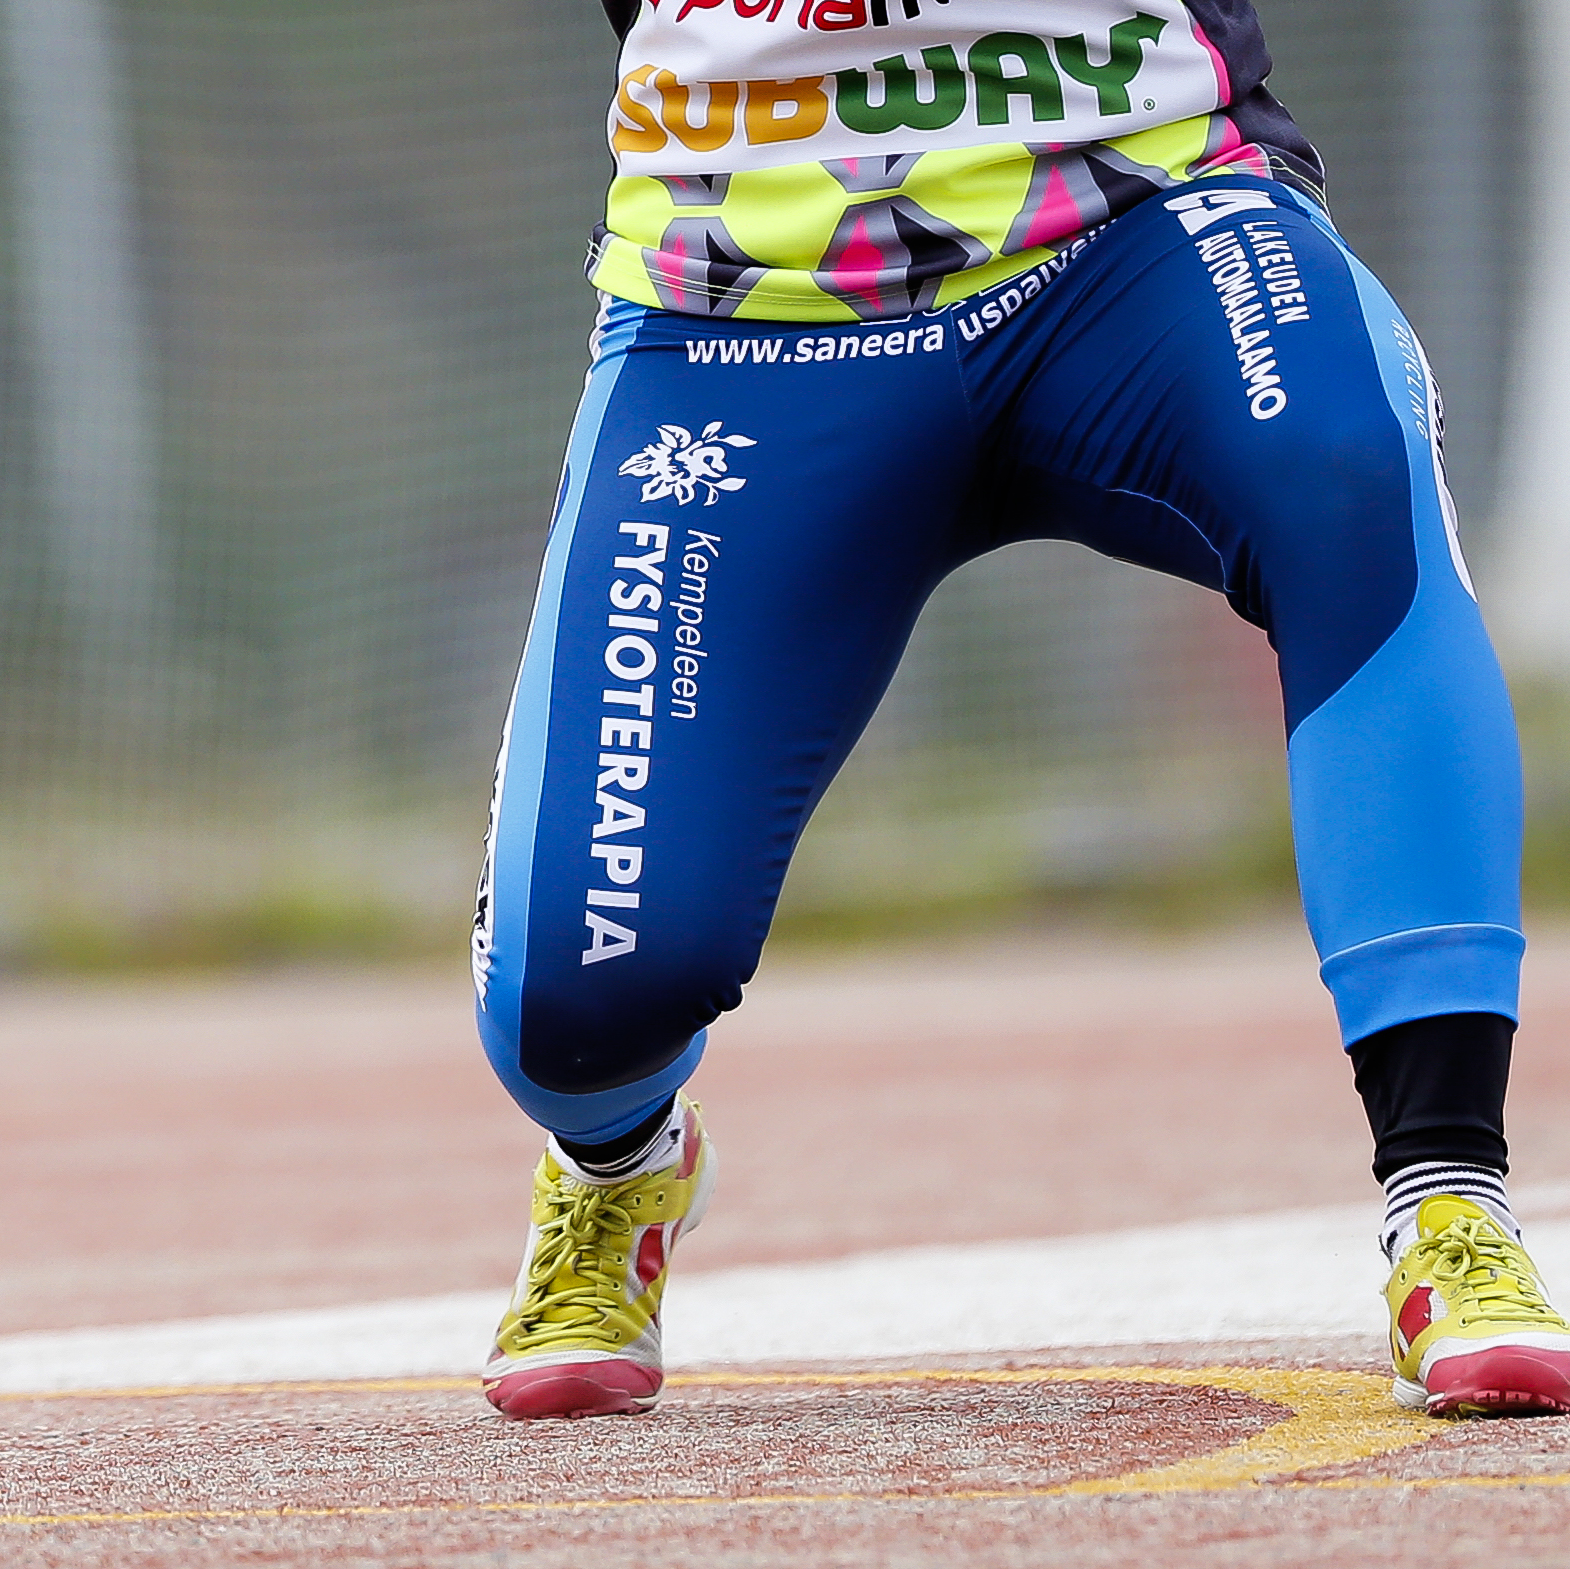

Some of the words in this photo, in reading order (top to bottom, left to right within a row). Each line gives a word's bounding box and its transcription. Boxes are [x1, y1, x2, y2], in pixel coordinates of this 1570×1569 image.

[612, 10, 1169, 155] SUBWAY
[1194, 229, 1287, 420] AUTOMAALAAMO
[1243, 222, 1310, 325] LAKEUDEN
[670, 528, 721, 721] Kempeleen
[581, 520, 669, 966] FYSIOTERAPIA
